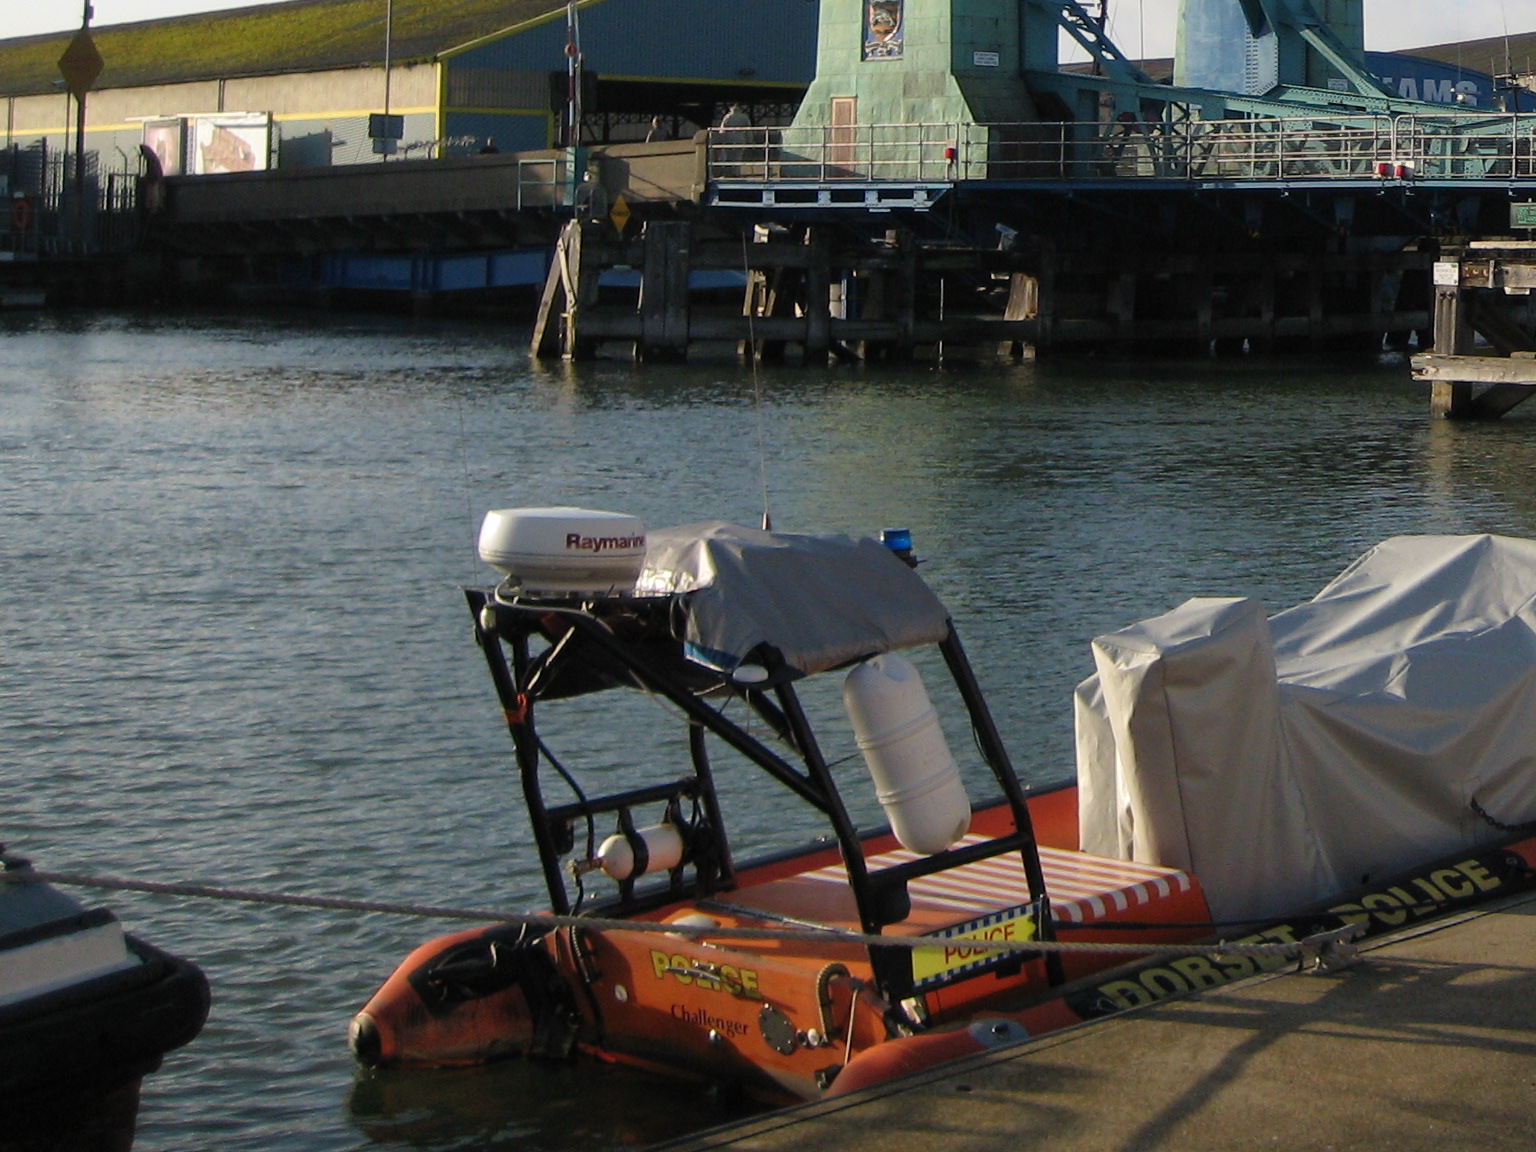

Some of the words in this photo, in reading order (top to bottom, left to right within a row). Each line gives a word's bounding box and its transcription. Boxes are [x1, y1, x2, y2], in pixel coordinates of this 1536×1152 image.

[1327, 859, 1501, 945] POLICE
[650, 948, 764, 1002] POLICE
[670, 1004, 749, 1038] Challenger
